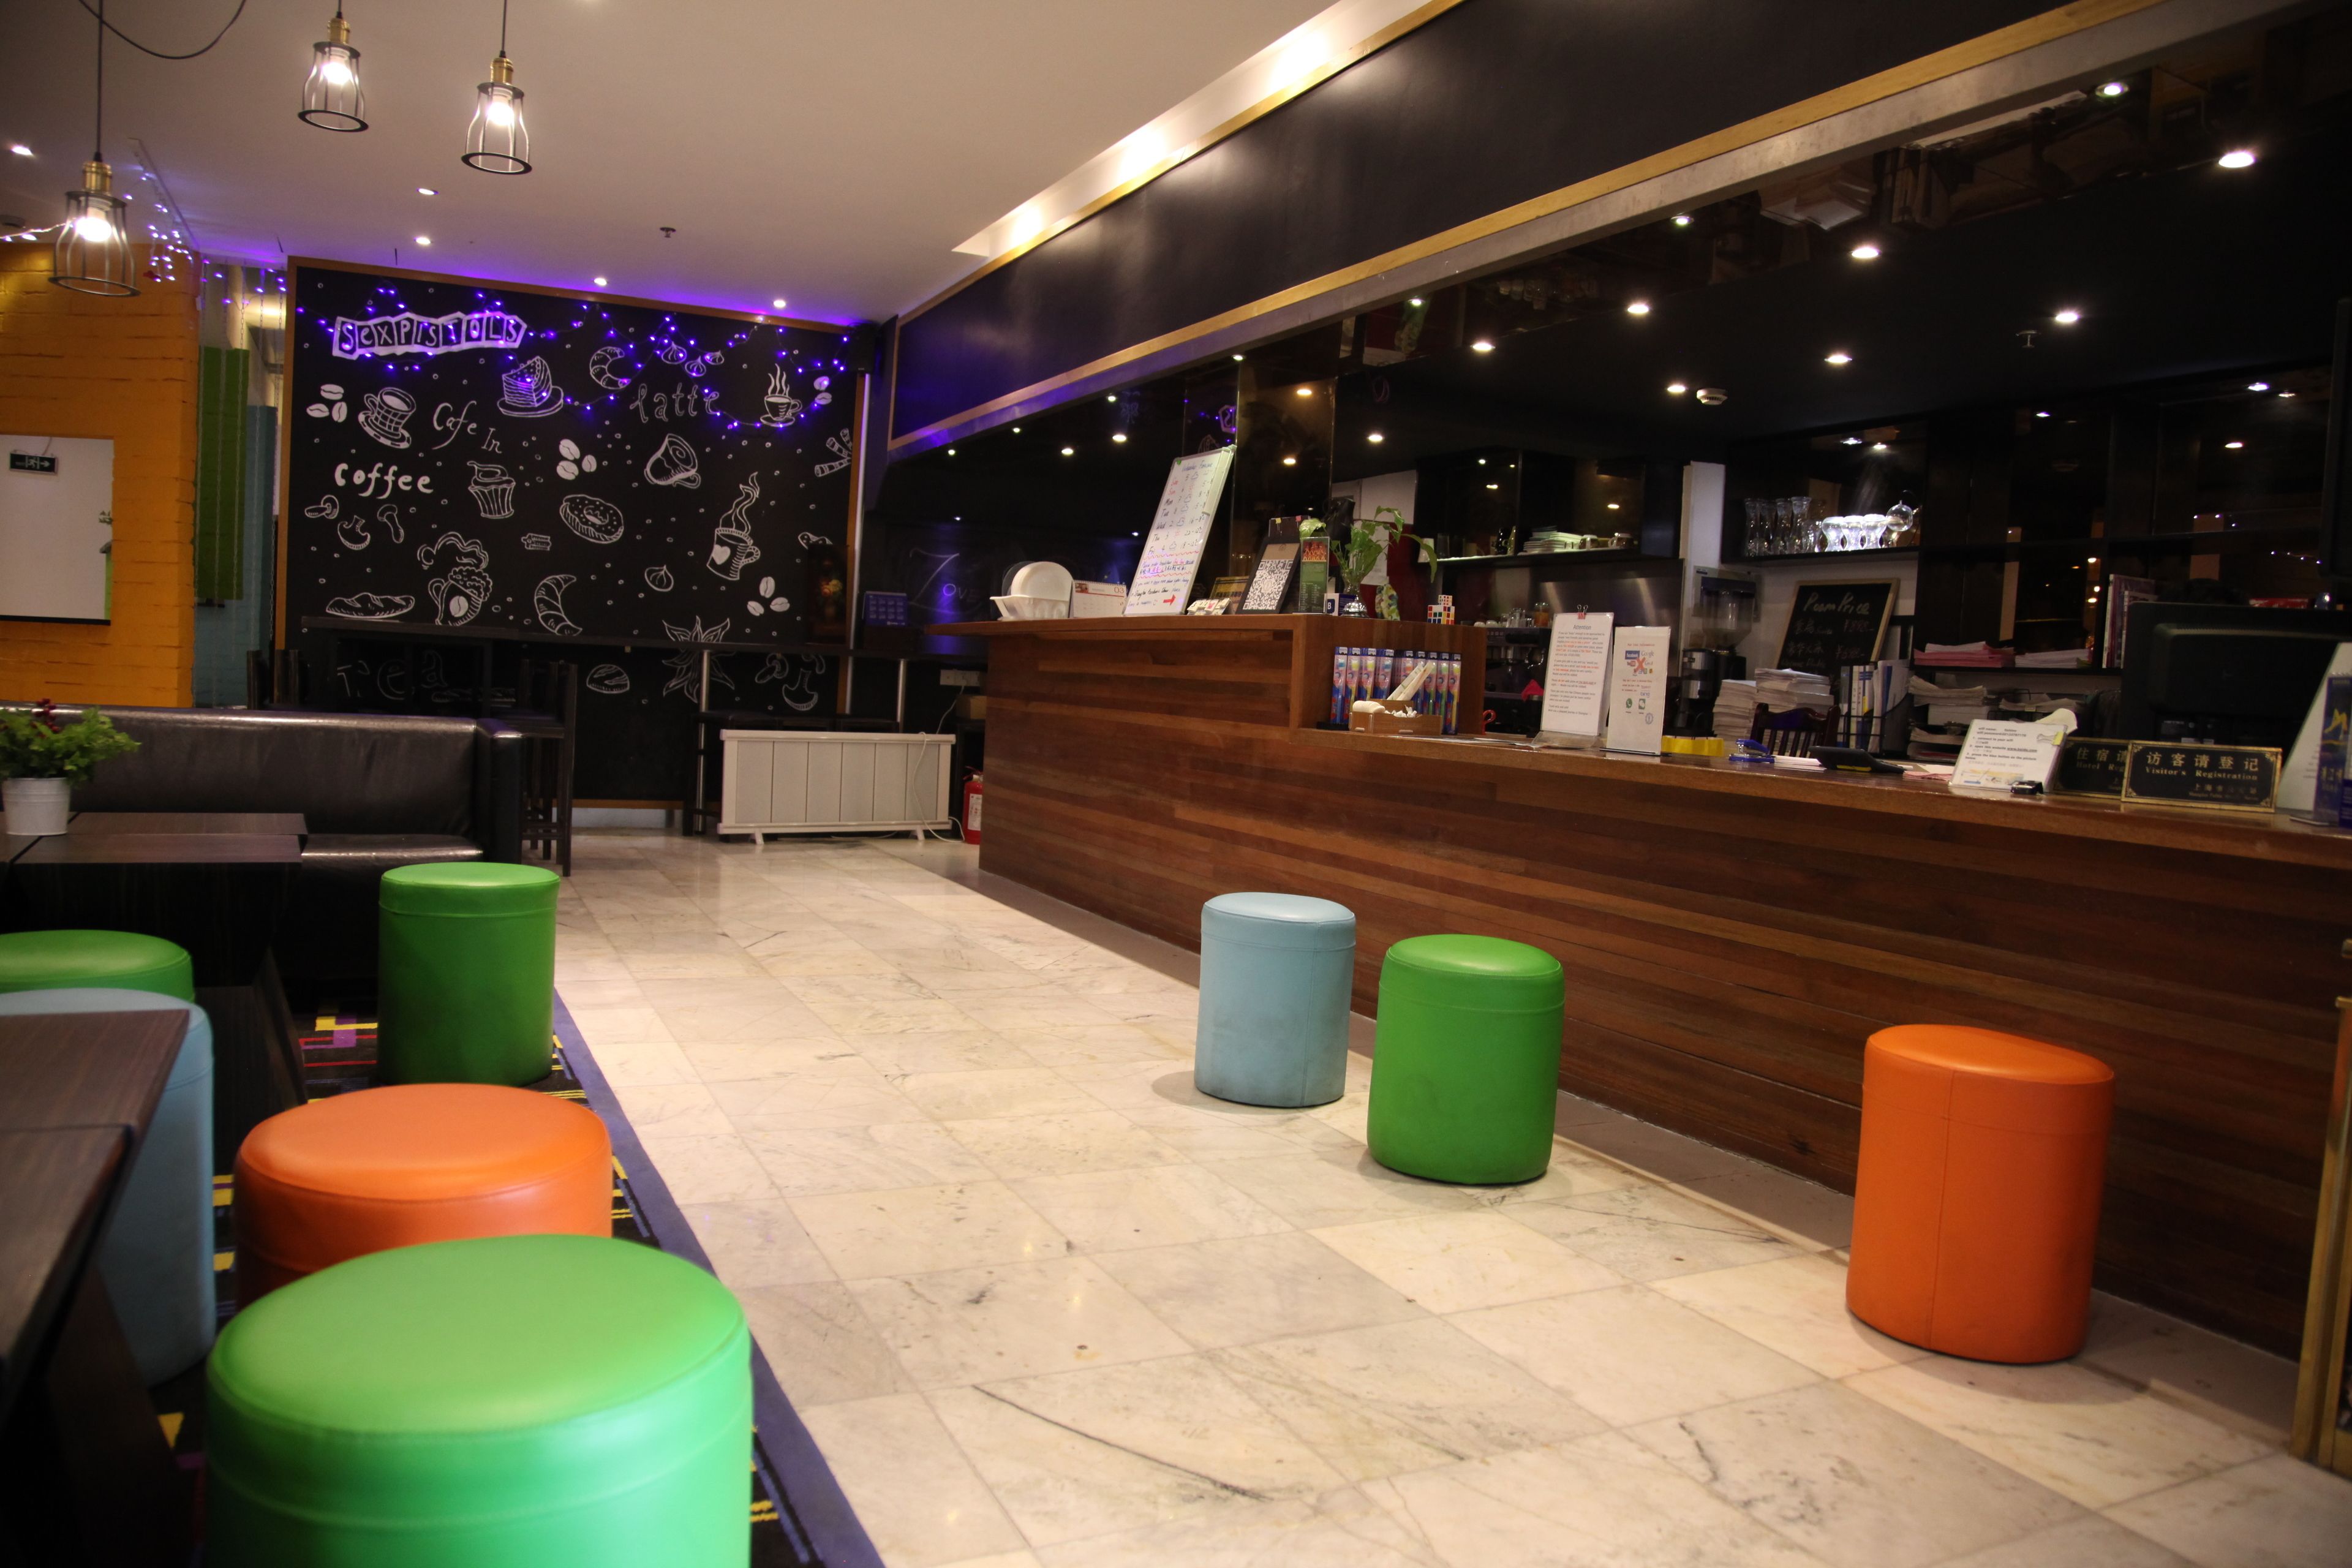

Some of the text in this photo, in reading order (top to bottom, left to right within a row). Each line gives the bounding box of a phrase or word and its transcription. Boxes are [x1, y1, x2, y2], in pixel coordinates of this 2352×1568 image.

[432, 401, 477, 450] Cafe
[481, 428, 502, 454] In
[334, 463, 434, 499] Coffee
[1161, 508, 1169, 518] Tue
[1152, 534, 1160, 543] Thu
[1327, 601, 1332, 610] B
[1803, 592, 1870, 614] Room Price
[2076, 761, 2100, 770] Hotel
[2146, 752, 2259, 772] 访客请登记
[2146, 766, 2258, 781] Visitor's Registration
